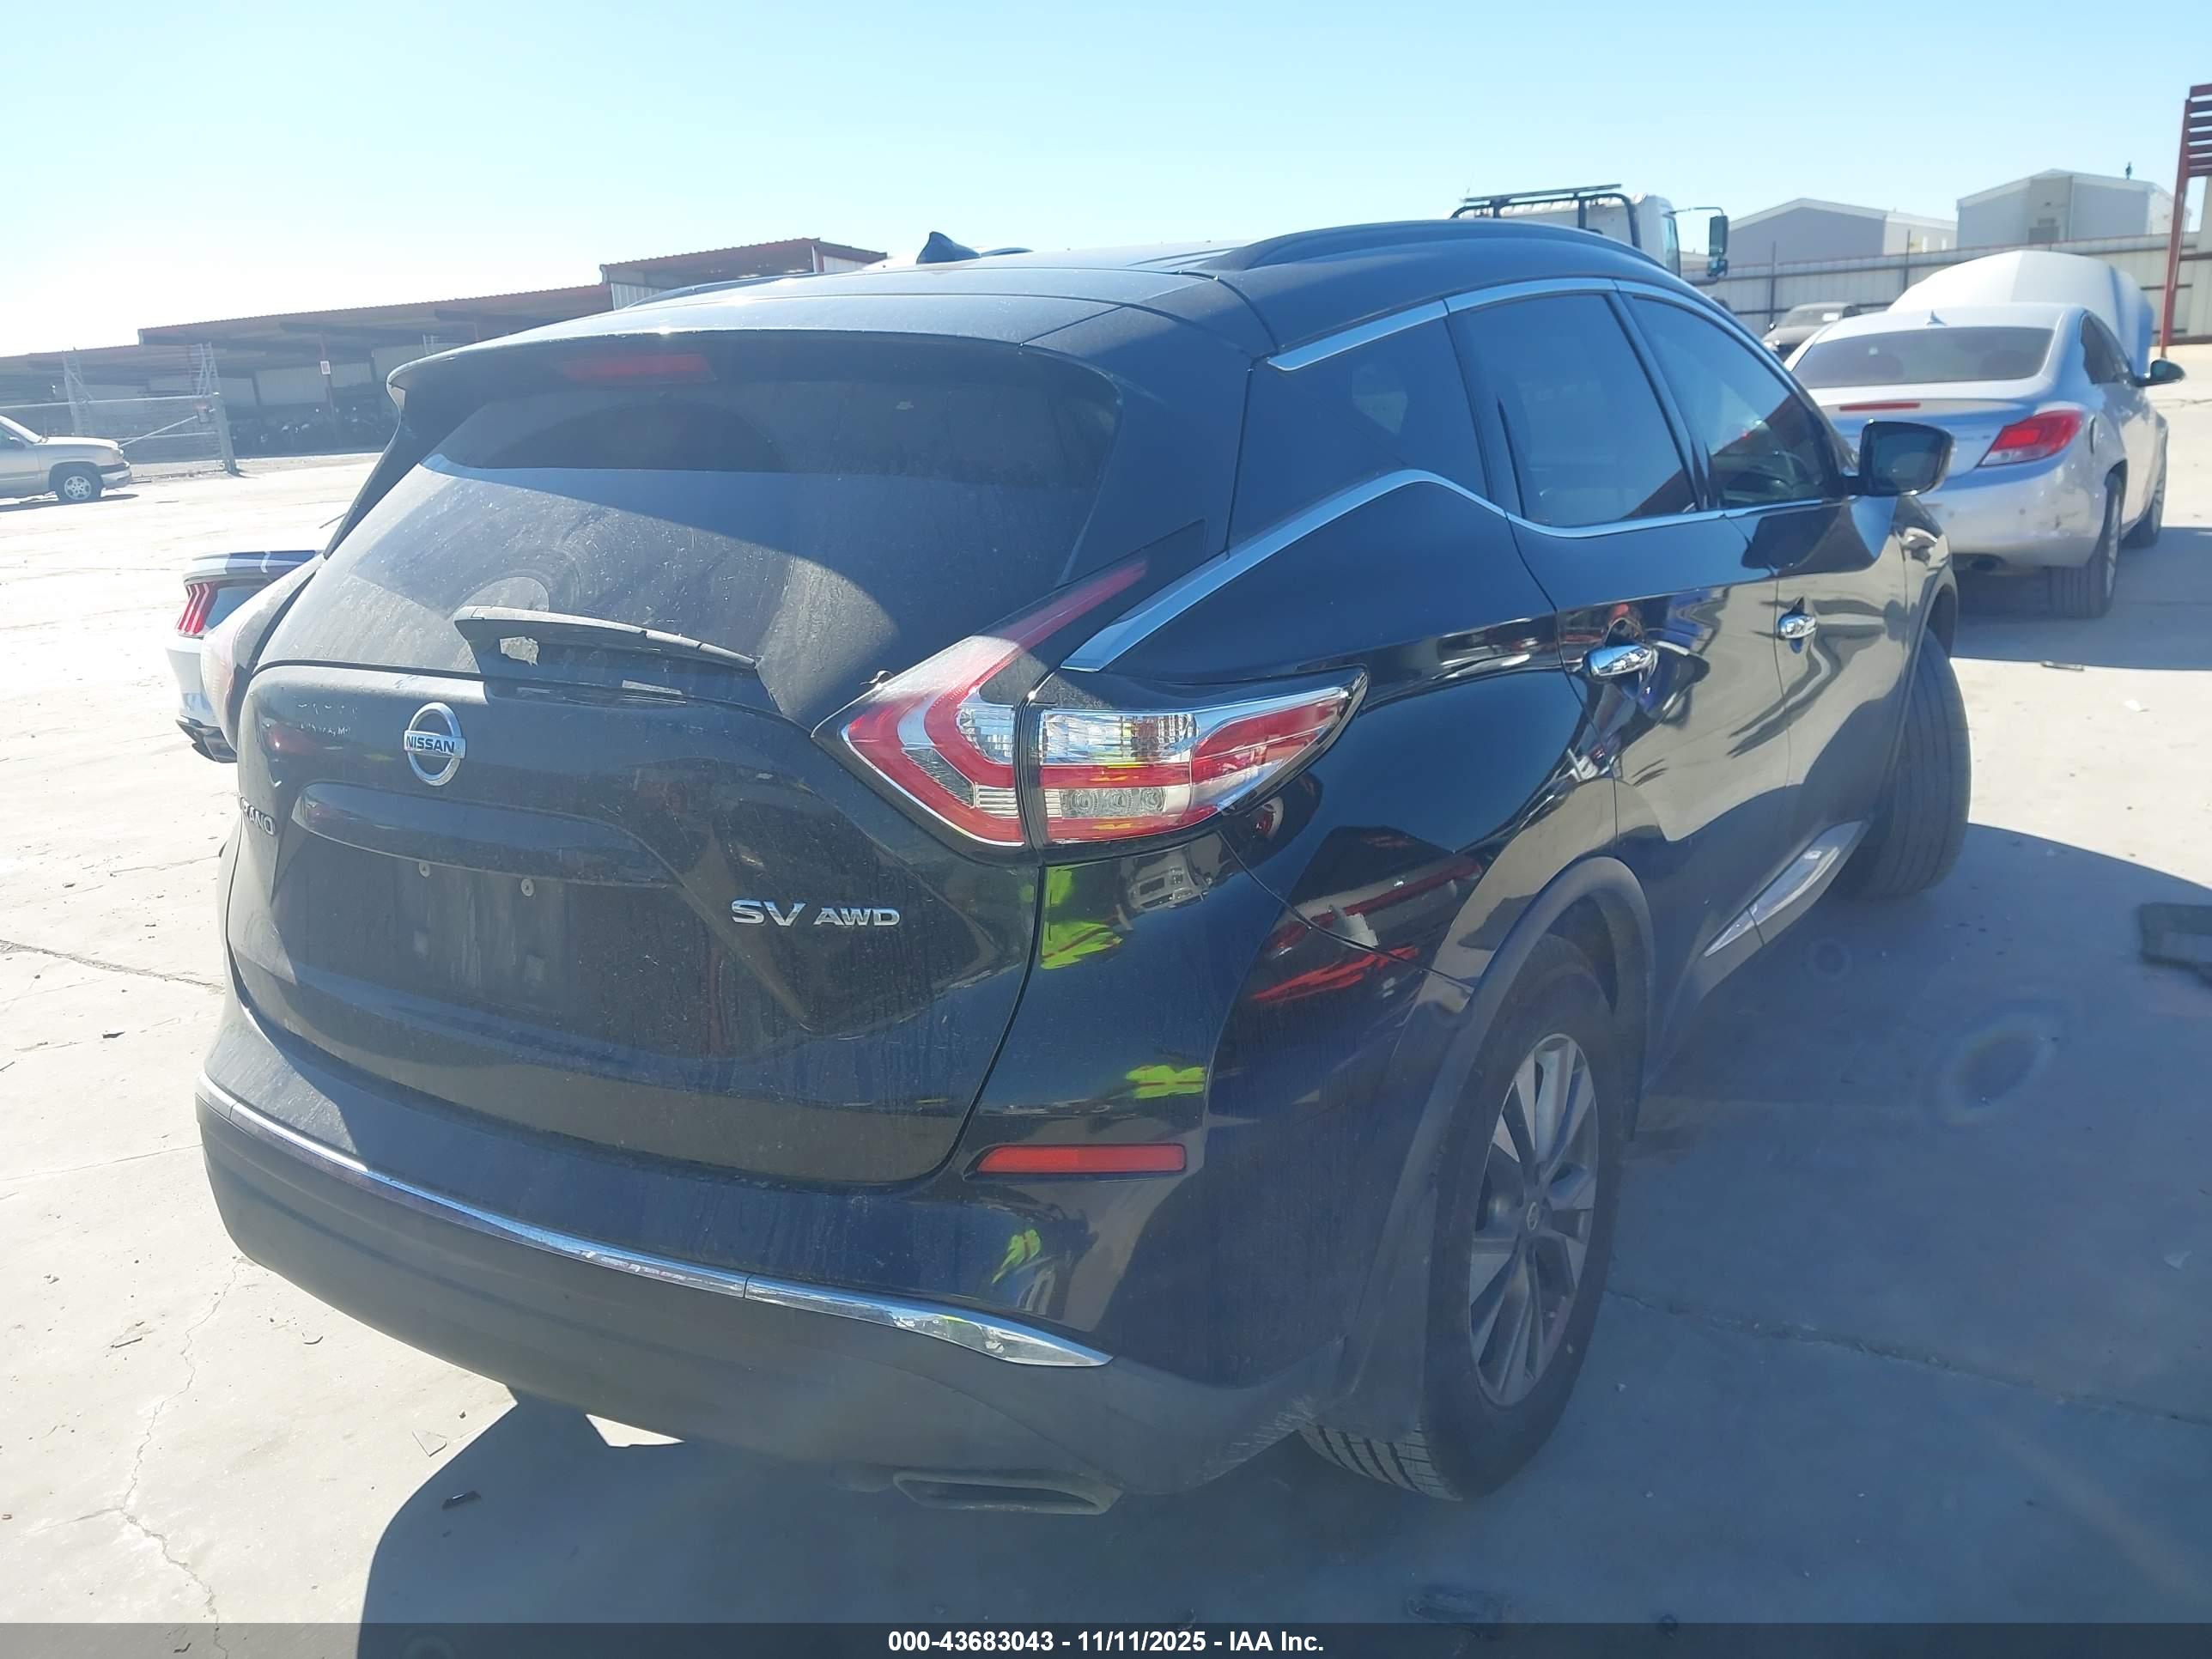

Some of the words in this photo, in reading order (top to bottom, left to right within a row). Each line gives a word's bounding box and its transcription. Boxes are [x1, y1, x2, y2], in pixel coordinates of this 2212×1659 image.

[406, 735, 455, 753] NISSAN
[731, 899, 806, 927] SV
[813, 907, 901, 927] AWD
